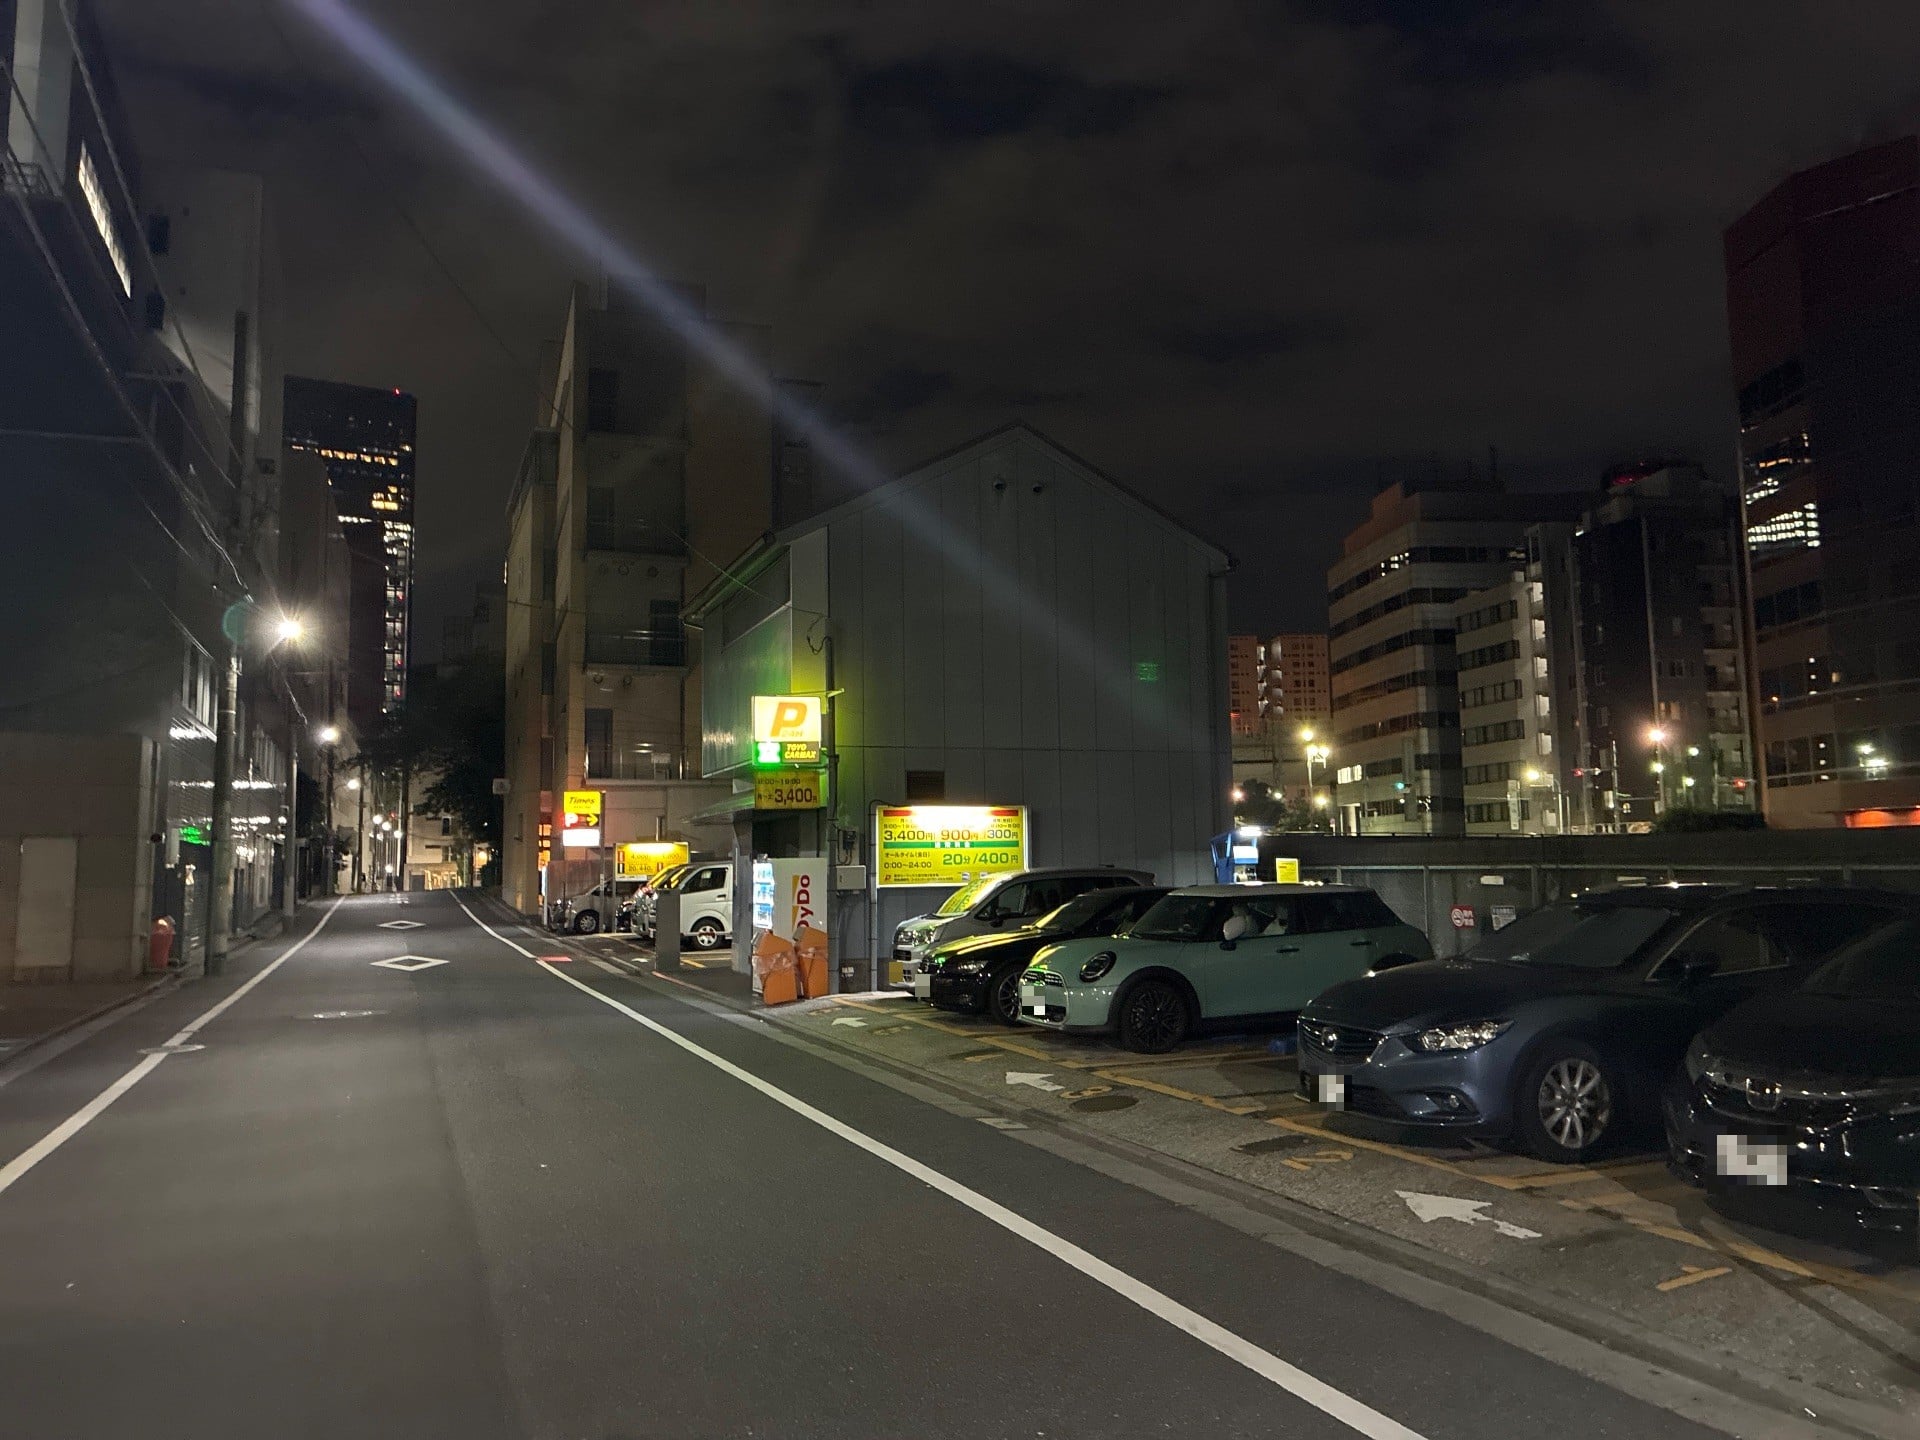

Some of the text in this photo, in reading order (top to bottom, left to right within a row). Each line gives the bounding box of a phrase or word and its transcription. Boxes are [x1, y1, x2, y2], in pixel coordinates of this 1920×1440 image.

[770, 702, 807, 737] P
[786, 743, 807, 751] TOYO
[784, 751, 817, 759] CARMAX
[569, 797, 596, 805] Times
